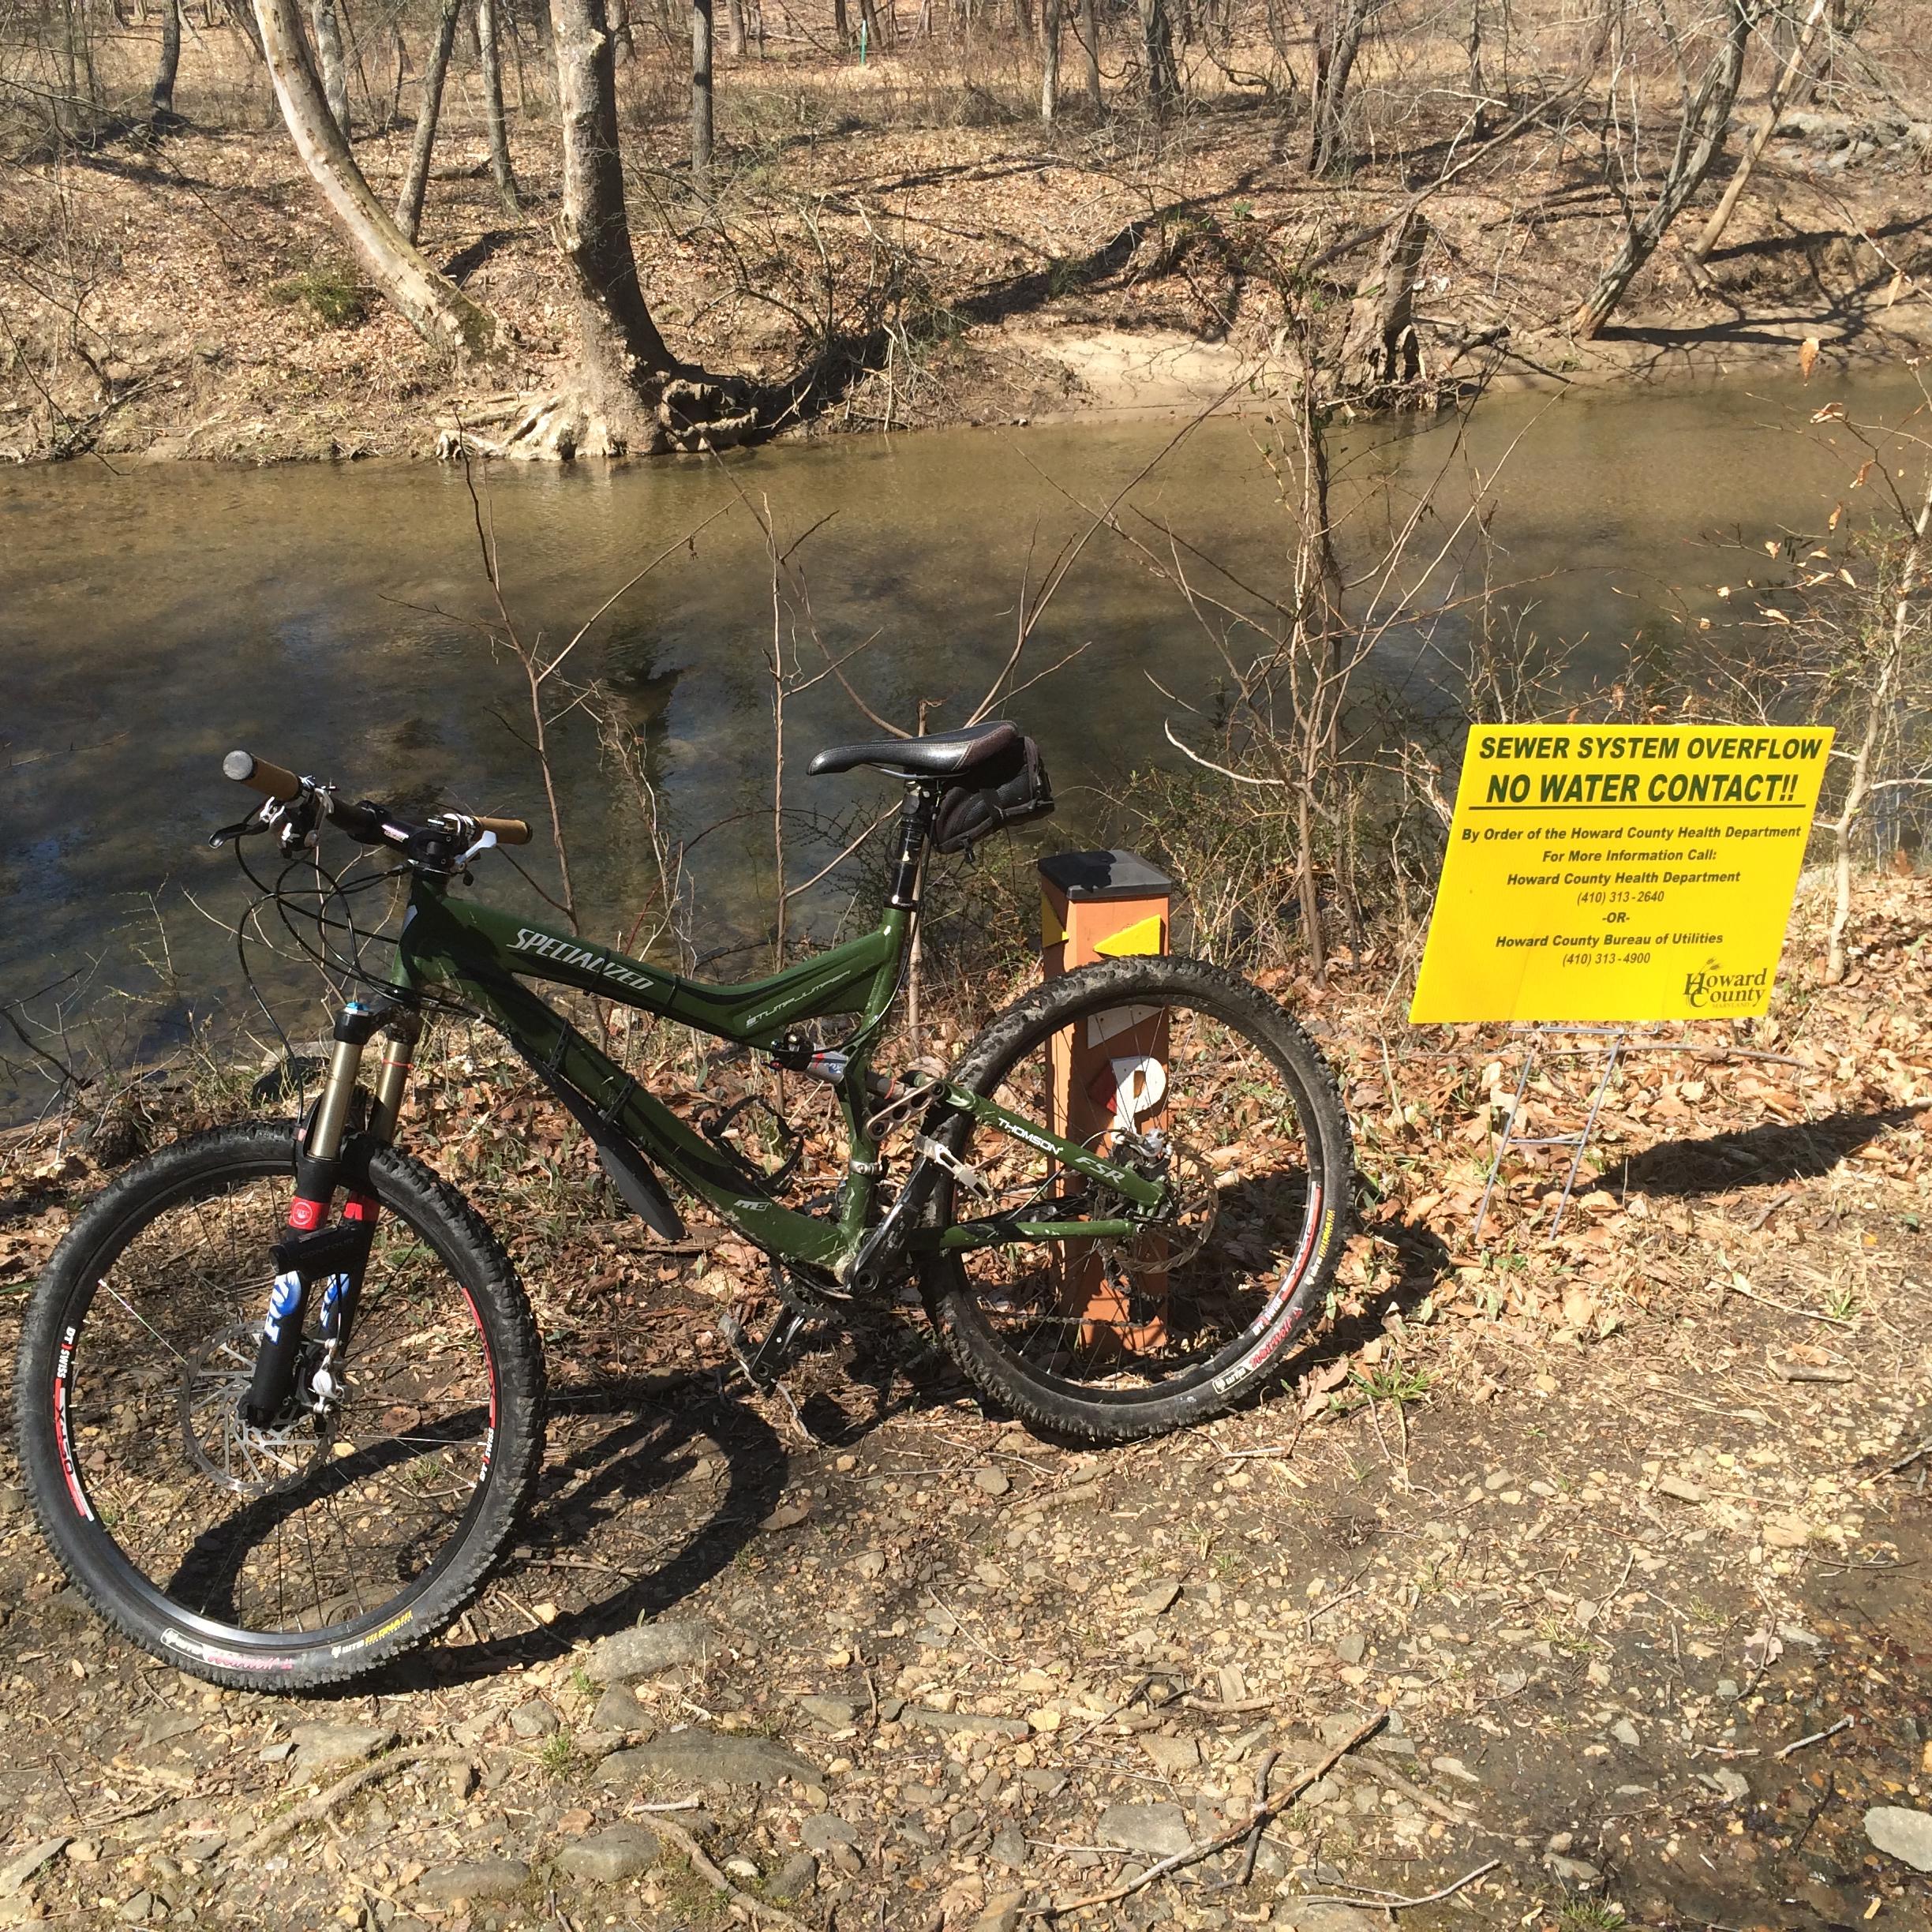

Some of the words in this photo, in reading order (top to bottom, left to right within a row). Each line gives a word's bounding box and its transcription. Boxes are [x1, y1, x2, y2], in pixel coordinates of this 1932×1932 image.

[1480, 737, 1570, 759] SEWER
[1578, 737, 1679, 758] SYSTEM
[1687, 738, 1823, 759] OVERFLOW
[1486, 774, 1530, 803] NO
[1541, 774, 1640, 802] WATER
[1648, 774, 1798, 802] CONTACT!!
[1462, 829, 1480, 843] By
[1484, 829, 1523, 840] Order
[1527, 828, 1542, 839] of
[1545, 828, 1566, 839] the
[1571, 827, 1623, 839] Howard
[1627, 827, 1674, 841] County
[1678, 826, 1720, 837] Health
[1725, 826, 1801, 840] Department
[1543, 851, 1565, 862] For
[1568, 850, 1601, 861] More
[1606, 850, 1683, 861] Information
[1688, 849, 1717, 860] Call:
[1507, 874, 1560, 885] Howard
[1564, 873, 1611, 886] County
[1615, 872, 1658, 883] Health
[1663, 872, 1740, 885] Department
[1578, 892, 1605, 905] (410)
[1609, 891, 1664, 902] 313-2640
[1602, 912, 1630, 923] -OR-
[1496, 935, 1548, 947] Howard
[1553, 935, 1600, 948] County
[1604, 934, 1651, 945] Bureau
[1656, 934, 1669, 944] of
[1672, 933, 1723, 944] Utilities
[506, 928, 655, 990] SPECIALIZED
[1563, 954, 1591, 967] (410)
[1595, 953, 1650, 964] 313-4900
[1683, 968, 1768, 994] Howard
[1690, 987, 1765, 1007] County
[998, 1117, 1061, 1155] THOMSON
[1074, 1156, 1126, 1185] FSR
[64, 1326, 77, 1345] DT
[57, 1349, 71, 1379] SWISS
